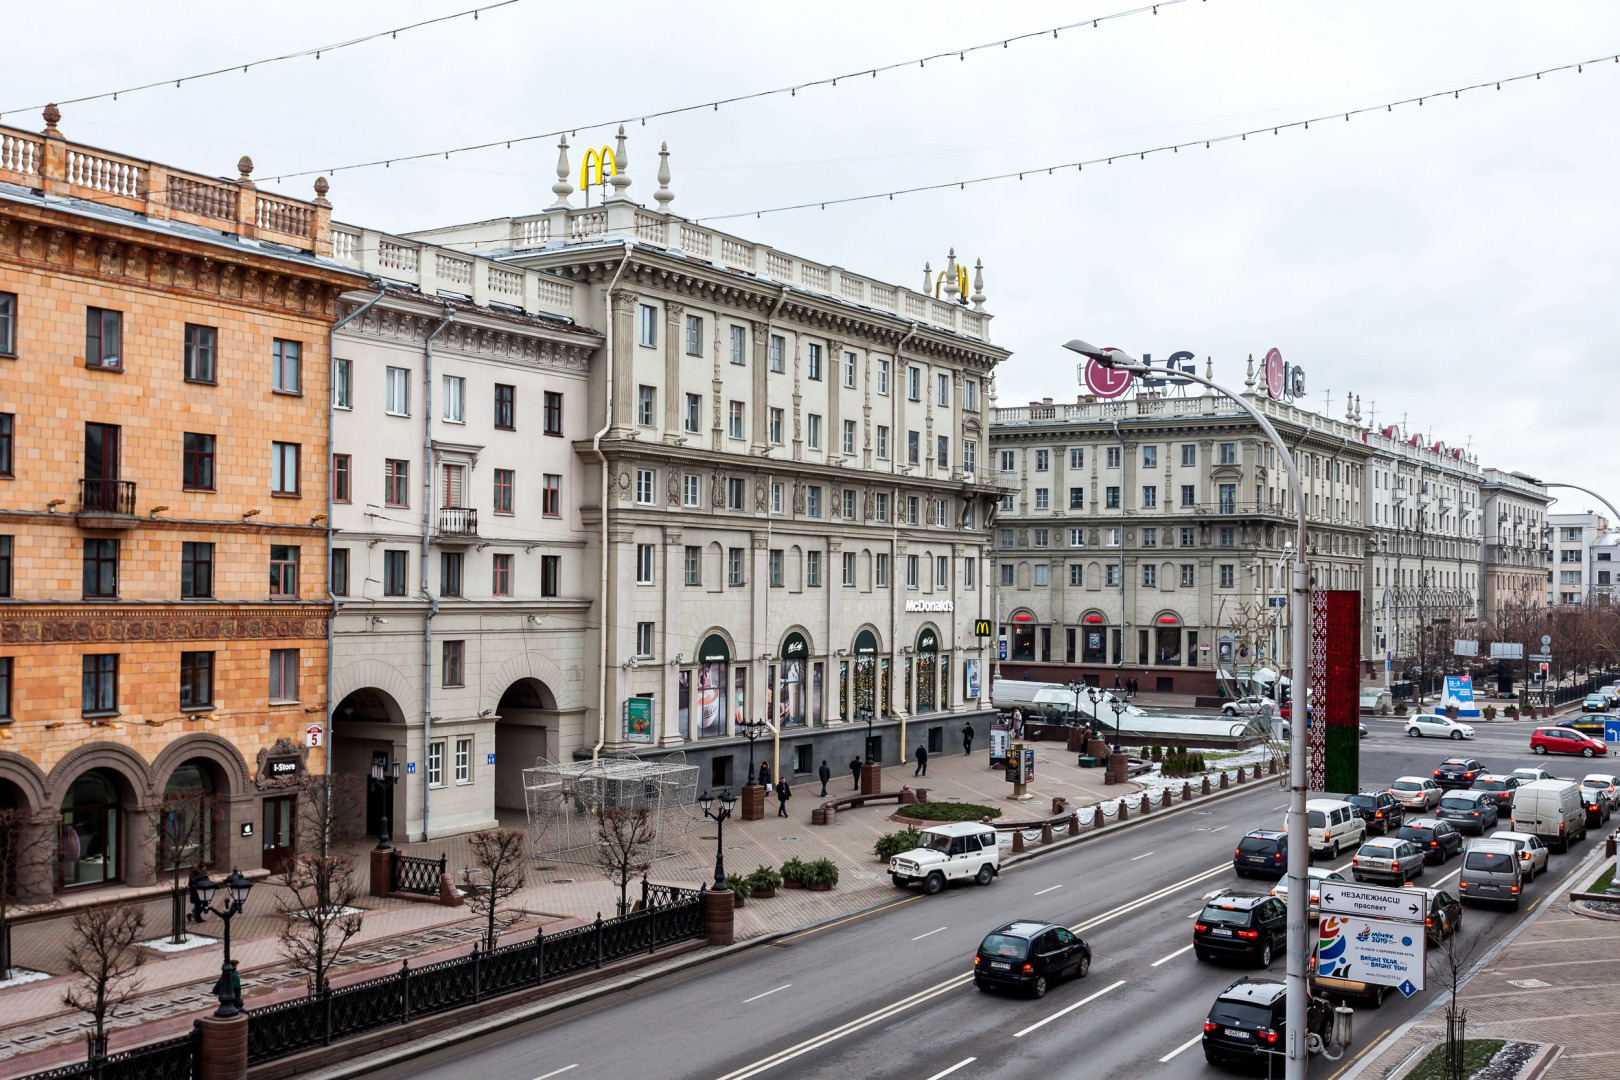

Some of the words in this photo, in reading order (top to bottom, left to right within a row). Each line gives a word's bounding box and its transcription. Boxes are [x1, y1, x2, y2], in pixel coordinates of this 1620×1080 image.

[1143, 350, 1196, 388] LG
[905, 600, 954, 612] McDonald's
[312, 734, 318, 746] 5
[1341, 891, 1400, 904] НЕЗАЛЕЖНАСЦІ
[1354, 902, 1386, 911] праспект
